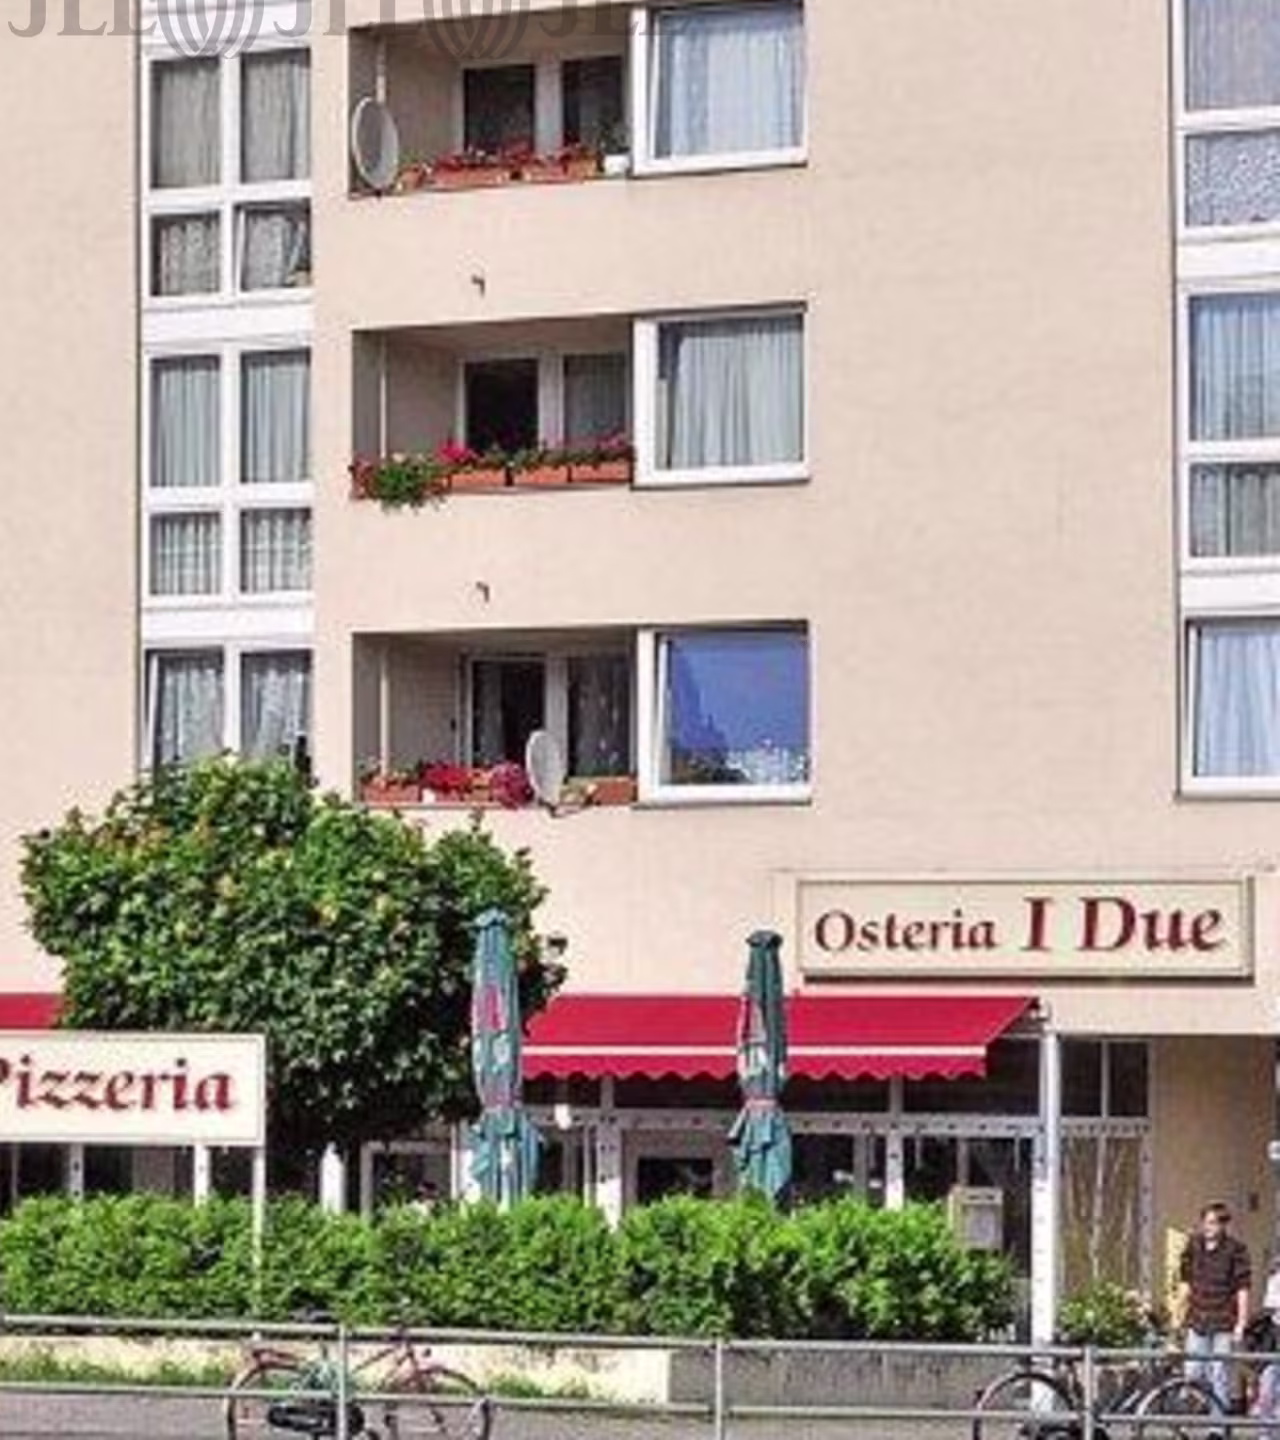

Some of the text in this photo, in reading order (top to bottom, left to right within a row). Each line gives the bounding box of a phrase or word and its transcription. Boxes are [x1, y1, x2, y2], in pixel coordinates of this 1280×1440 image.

[813, 896, 1227, 952] Osteria I Due
